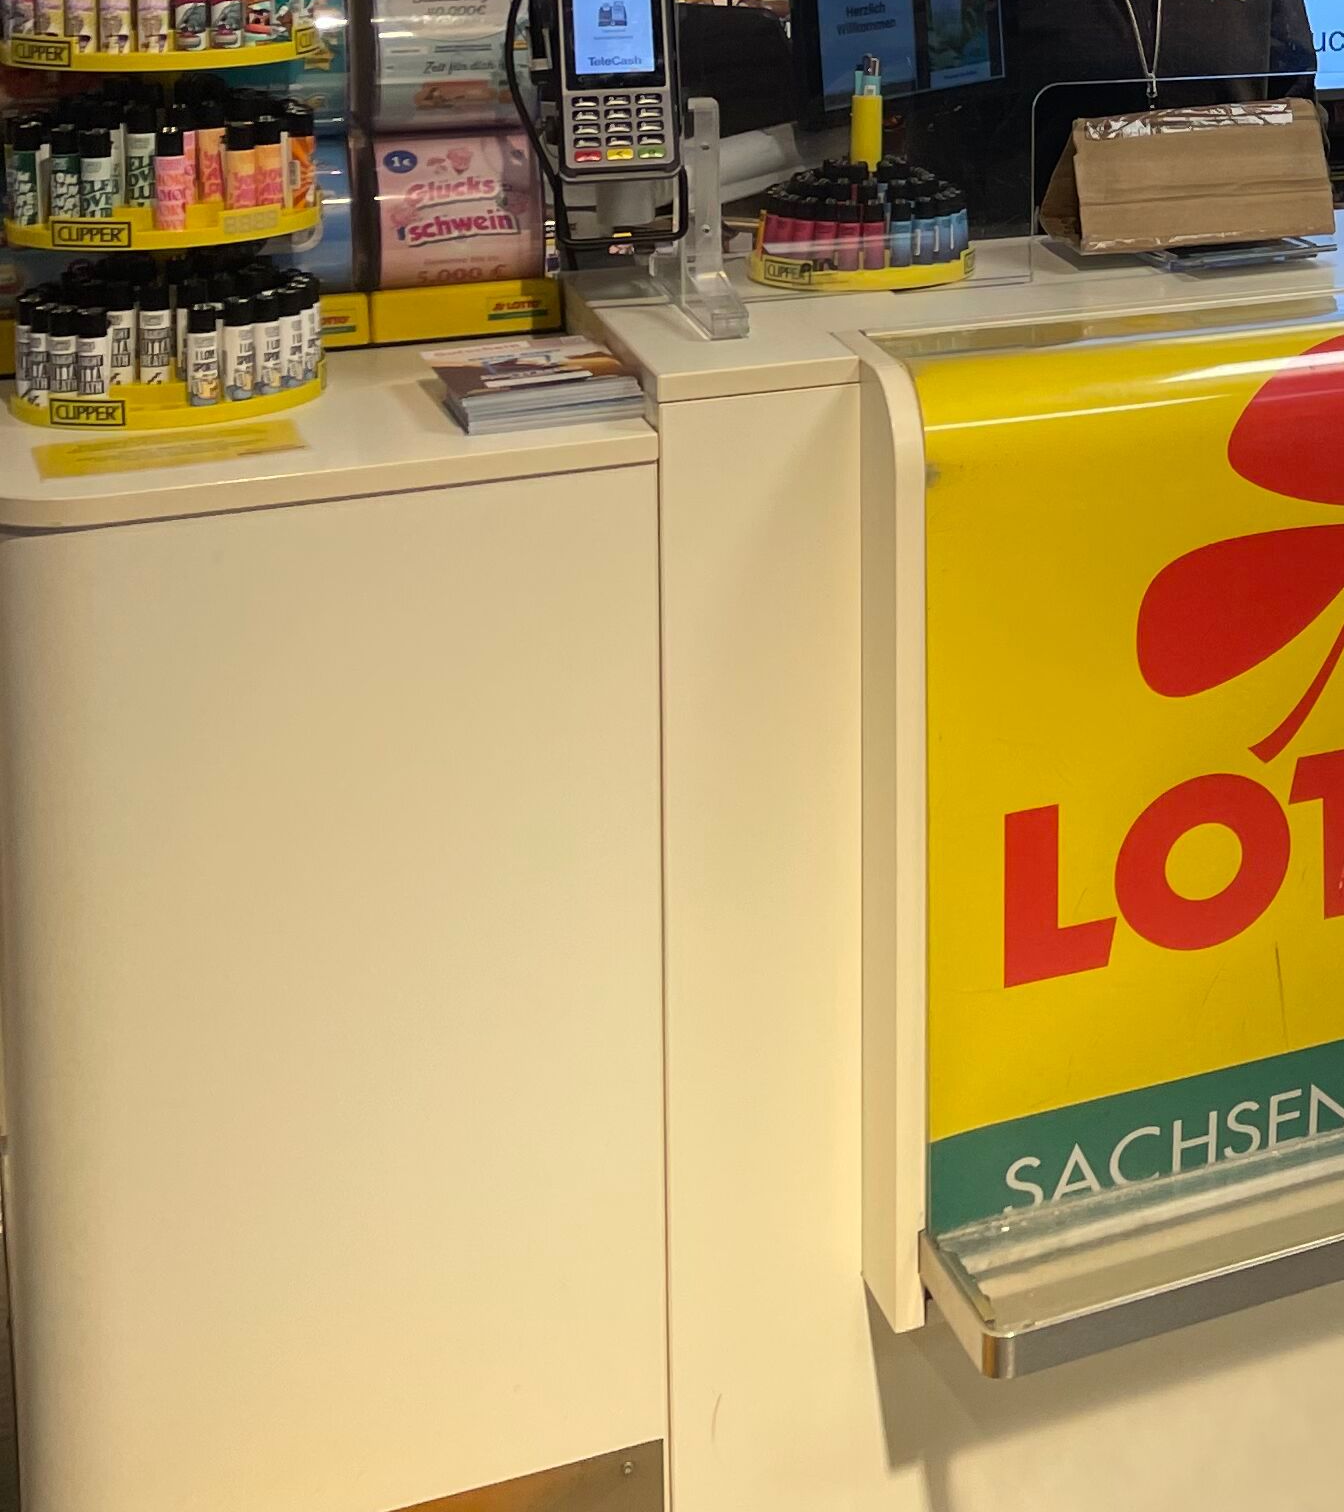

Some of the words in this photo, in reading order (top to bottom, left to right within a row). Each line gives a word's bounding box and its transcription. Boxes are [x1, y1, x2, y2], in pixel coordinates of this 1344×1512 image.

[14, 44, 66, 63] CLIPPER
[406, 177, 494, 203] Glücks
[57, 226, 122, 244] CLIPPER
[408, 210, 512, 242] schwein
[418, 267, 484, 284] 5.000
[765, 264, 811, 282] CLIPPER
[55, 405, 117, 422] CLIPPER
